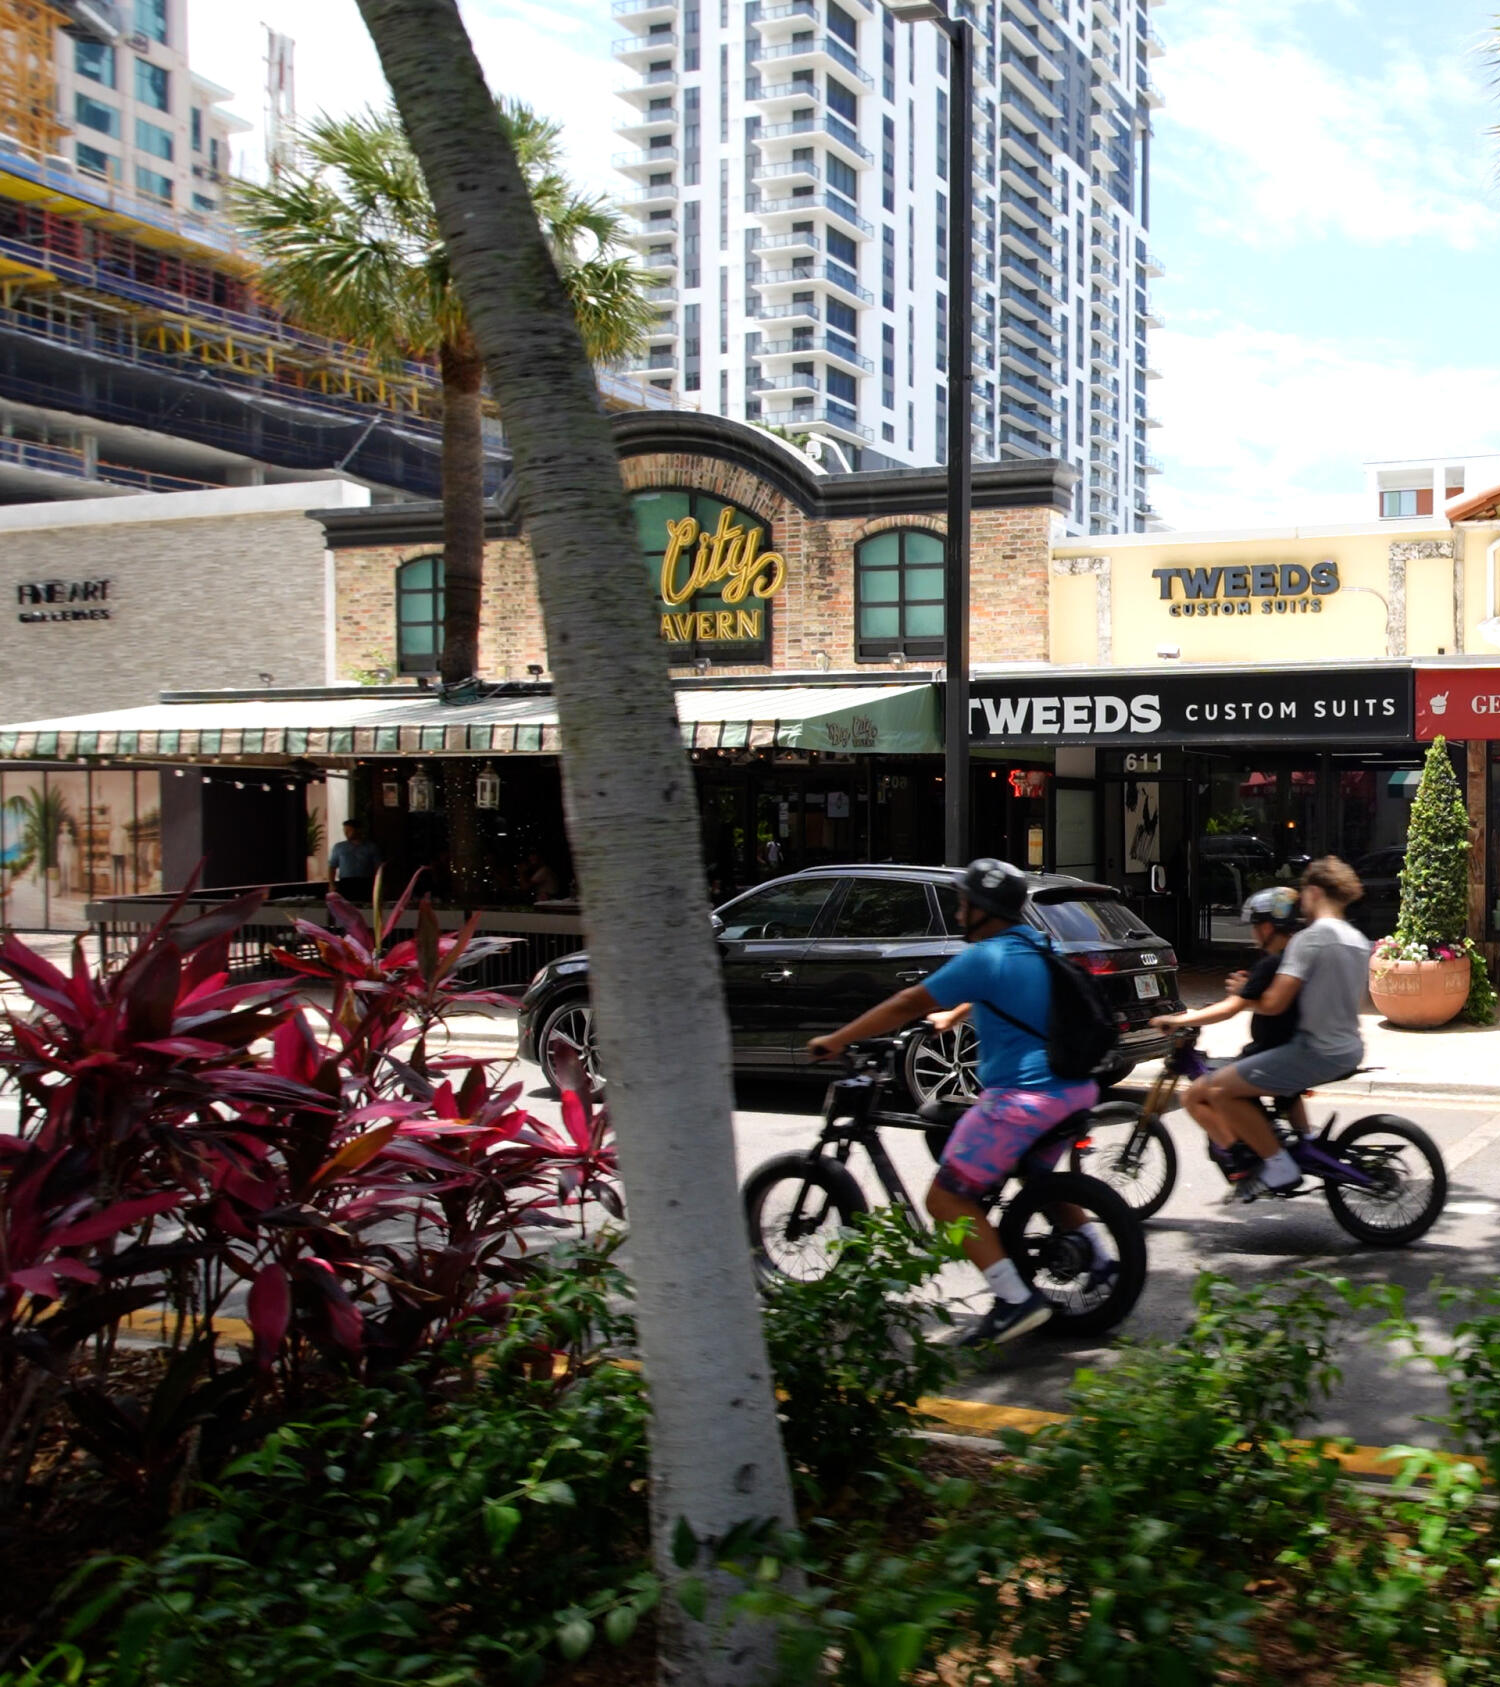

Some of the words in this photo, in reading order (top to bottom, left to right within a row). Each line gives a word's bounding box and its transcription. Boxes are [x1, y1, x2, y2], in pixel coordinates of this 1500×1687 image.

[661, 506, 788, 606] City
[1152, 562, 1340, 600] TWEEDS
[1169, 601, 1251, 617] CUSTOM
[1261, 599, 1322, 614] SUITS
[661, 609, 760, 642] AVERN
[1185, 701, 1297, 721] CUSTOM
[1313, 698, 1396, 718] SUITS
[1125, 753, 1162, 771] 611
